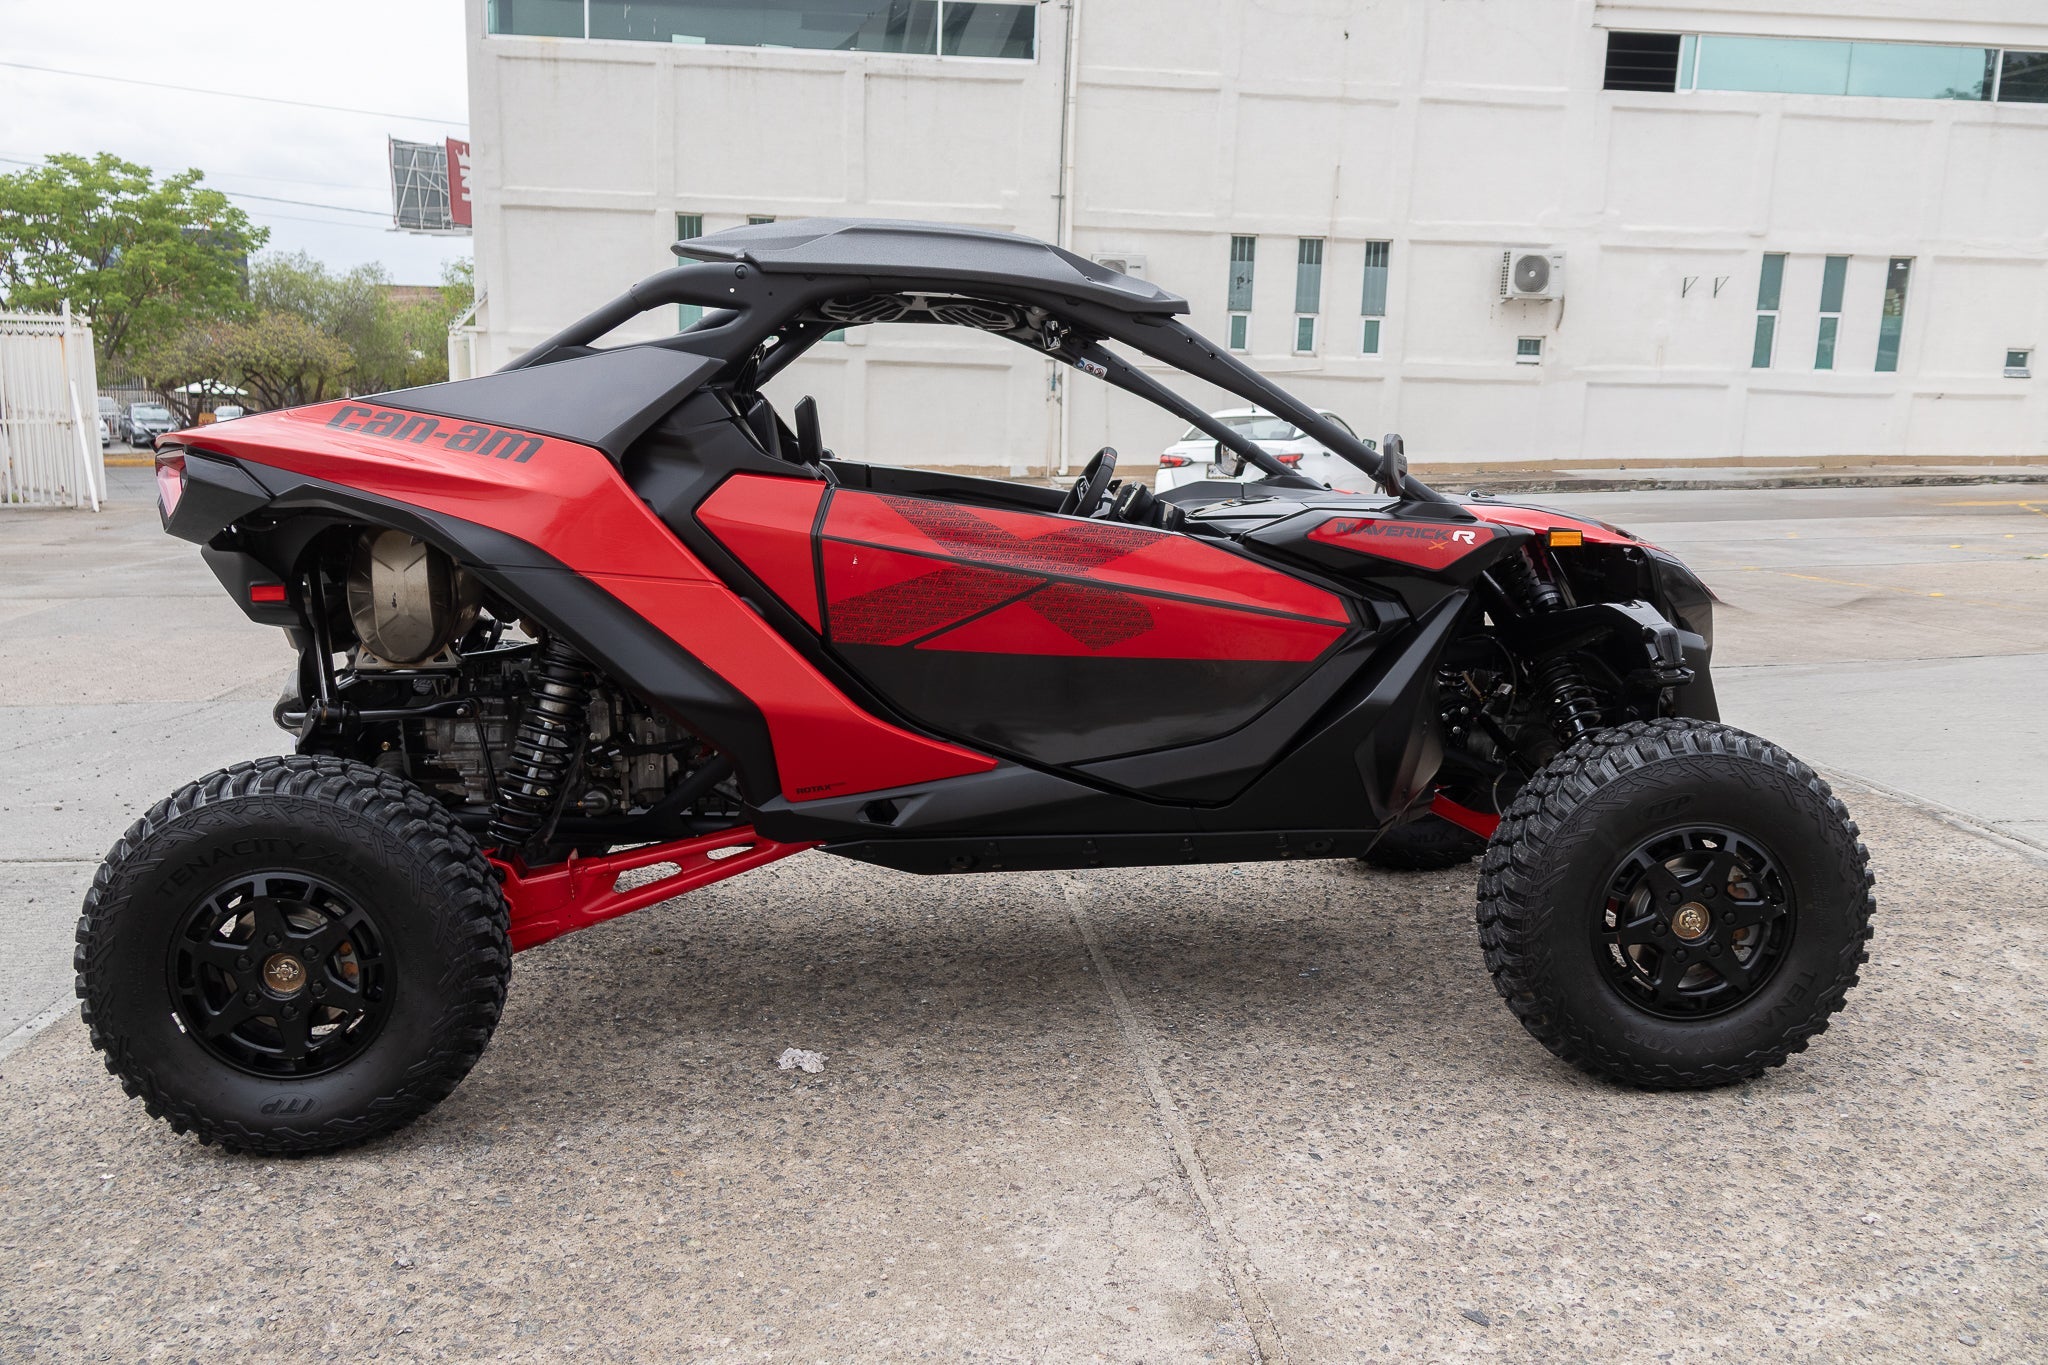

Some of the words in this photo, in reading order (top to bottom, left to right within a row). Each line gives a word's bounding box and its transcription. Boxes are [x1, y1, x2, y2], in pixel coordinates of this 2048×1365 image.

[325, 405, 545, 464] can-am
[1335, 522, 1452, 541] MAVERICK
[796, 784, 832, 795] ROTAX
[155, 837, 306, 897] TENACITY
[260, 1098, 315, 1115] ITP
